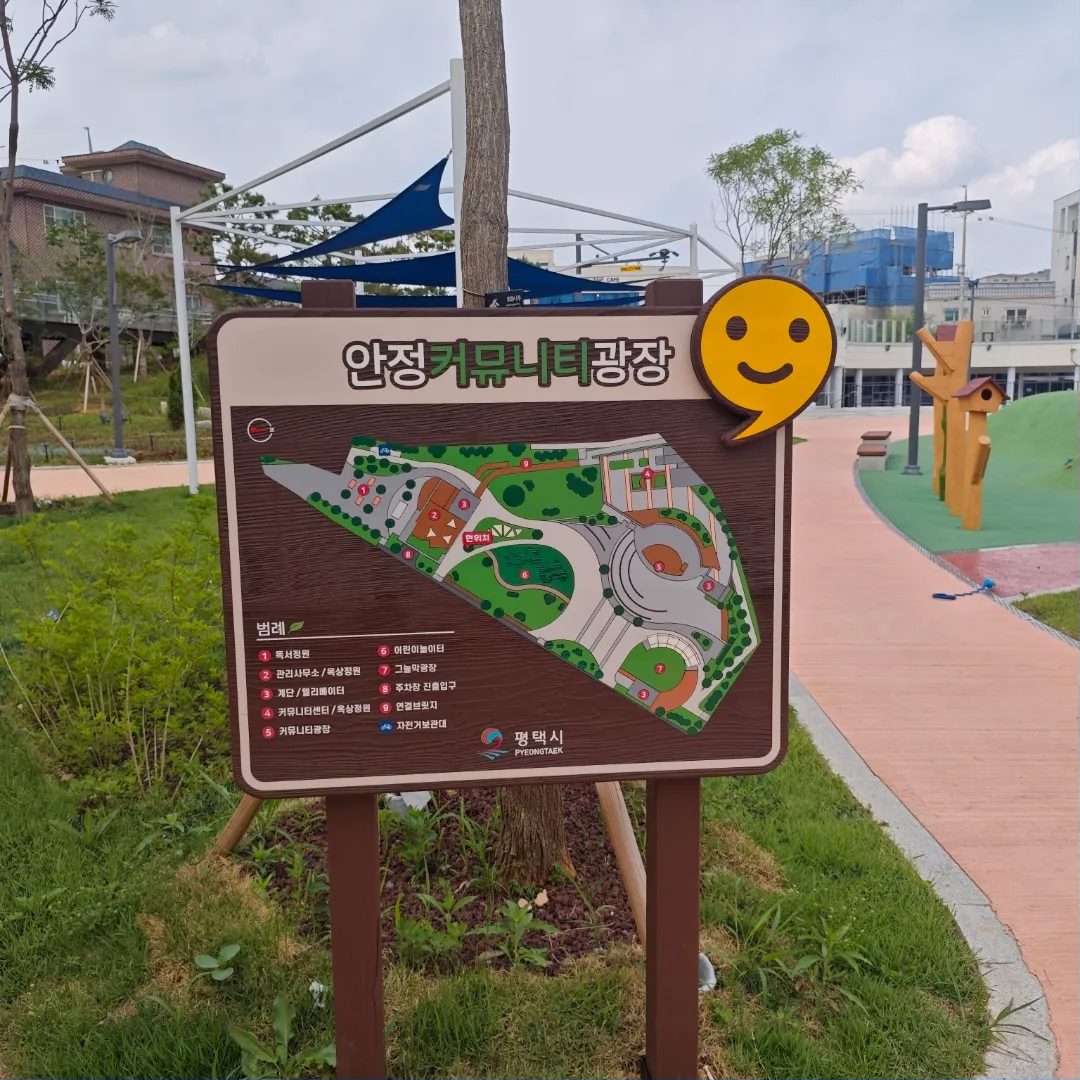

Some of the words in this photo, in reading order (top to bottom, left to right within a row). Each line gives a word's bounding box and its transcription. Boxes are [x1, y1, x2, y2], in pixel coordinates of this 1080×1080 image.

[465, 534, 490, 543] 현위치
[256, 621, 286, 636] 범례
[275, 649, 310, 659] 독서정원
[394, 644, 445, 655] 어린이놀이터
[395, 663, 437, 674] 그늘막광장
[395, 683, 420, 692] 주차장
[423, 681, 457, 691] 진출입구
[396, 701, 438, 711] 연결브릿지
[279, 724, 331, 735] 커뮤니티광장
[396, 719, 447, 730] 자전거보관대
[514, 729, 563, 747] 평택시
[514, 747, 563, 756] PYEONGTAEK
